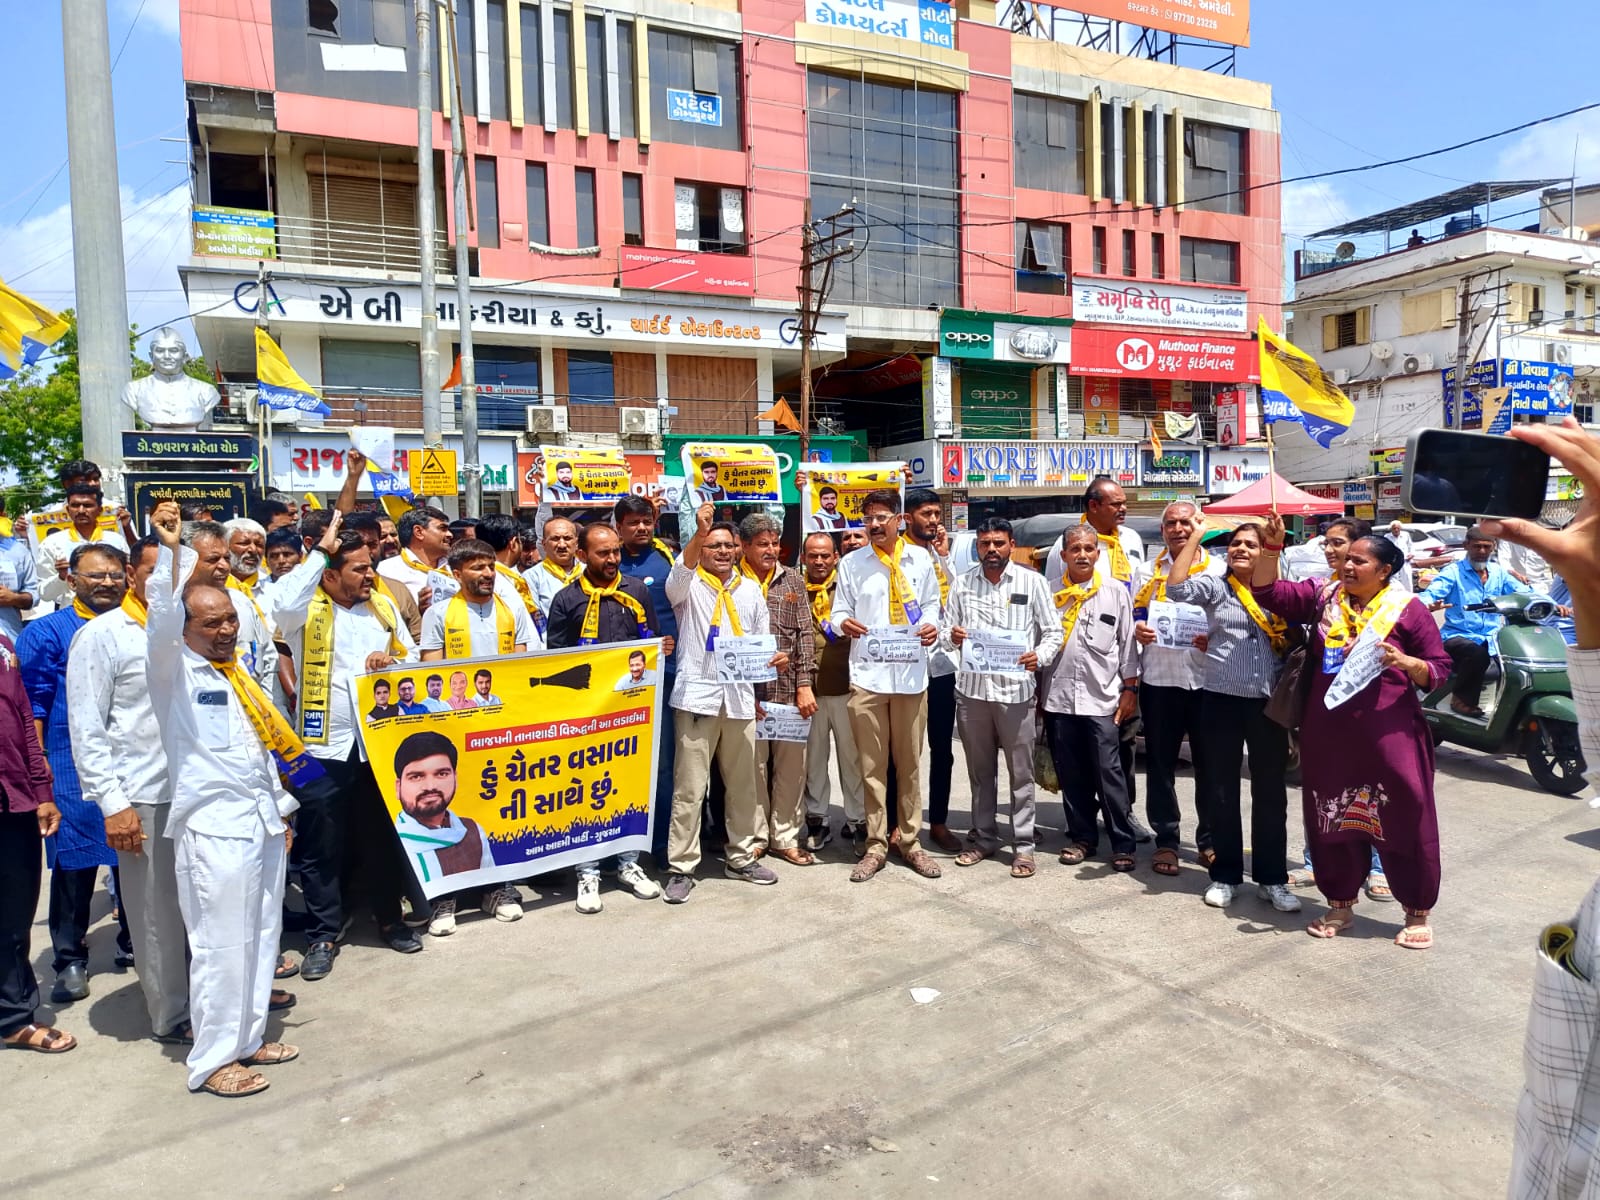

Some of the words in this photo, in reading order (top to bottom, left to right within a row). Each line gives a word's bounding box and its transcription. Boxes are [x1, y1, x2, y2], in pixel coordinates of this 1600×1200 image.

[923, 28, 950, 45] મોલ
[674, 95, 713, 113] પટેલ
[363, 290, 402, 322] બી
[550, 310, 564, 326] &
[1158, 340, 1200, 353] Muthoot
[1200, 343, 1237, 355] Finance
[191, 440, 218, 453] મહેતા
[220, 439, 239, 453] ચોક
[967, 446, 1039, 471] KORE
[1049, 446, 1136, 471] MOBILE
[1214, 465, 1242, 481] SUN
[470, 731, 513, 748] ભાજપની
[598, 720, 610, 728] આ
[479, 759, 499, 800] હું
[505, 748, 561, 783] ચૈતર
[567, 735, 639, 771] વસાવા
[499, 788, 527, 821] ની
[533, 777, 585, 815] સાથે
[525, 844, 544, 856] આમ
[545, 837, 571, 851] આદમી
[571, 830, 590, 845] પાર્ટી
[594, 825, 622, 842] ગુજરાત
